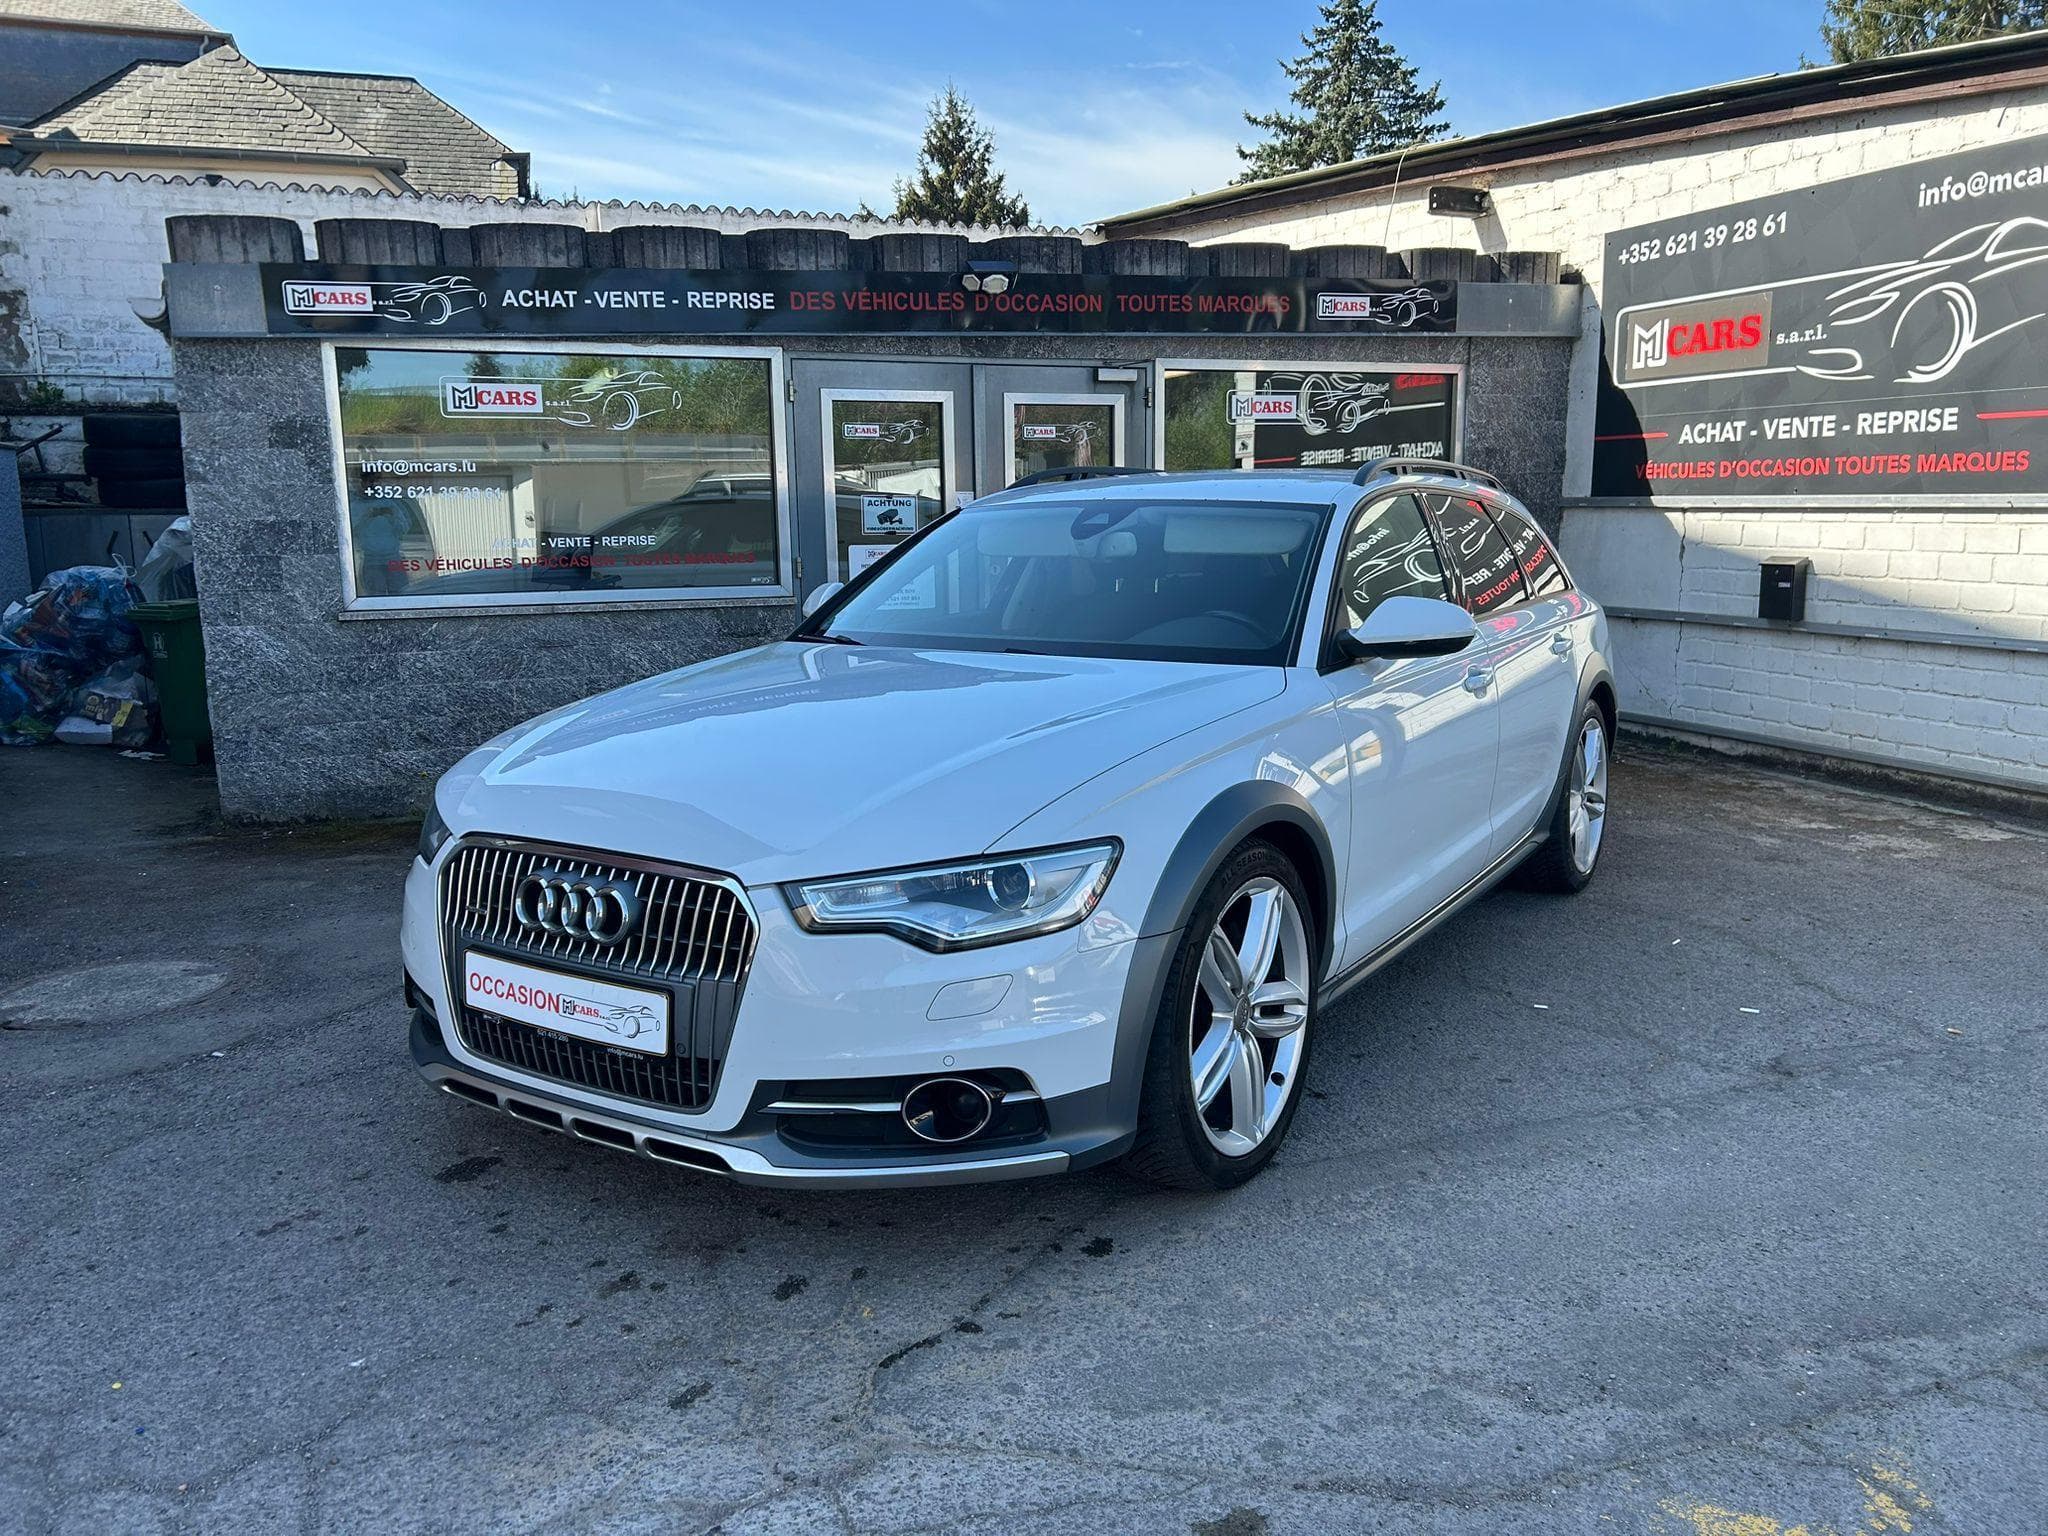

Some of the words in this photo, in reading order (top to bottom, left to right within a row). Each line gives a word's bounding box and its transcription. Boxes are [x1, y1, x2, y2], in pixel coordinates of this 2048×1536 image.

[1618, 238, 1661, 265] +352
[1665, 230, 1697, 257] 621
[1703, 224, 1728, 249] 39
[1732, 218, 1757, 243] 28
[1762, 211, 1787, 237] 61
[502, 289, 577, 308] ACHAT
[687, 291, 775, 310] REPRISE
[790, 291, 836, 311] DES
[841, 287, 965, 311] VÉHICULES
[975, 293, 1102, 313] D'OCCASION
[1117, 294, 1192, 313] TOUTES
[1199, 294, 1290, 314] MARQUES
[1667, 314, 1763, 359] CARS
[1775, 324, 1828, 345] s.a.r.l.
[477, 390, 537, 406] CARS
[1252, 401, 1293, 414] CARS
[1679, 421, 1746, 445] ACHAT
[1763, 415, 1837, 440] VENTE
[1856, 407, 1959, 435] REPRISE
[361, 460, 476, 475] info@mcars.lu
[1636, 460, 1715, 480] VÉHICULES
[1719, 457, 1831, 478] D'OCCASION
[1835, 454, 1911, 475] TOUTES
[1917, 450, 2030, 473] MARQUES
[364, 485, 402, 498] +352
[407, 485, 433, 499] 621
[439, 487, 458, 499] 39
[484, 487, 502, 499] 61
[867, 499, 912, 507] ACHTUNG
[492, 538, 537, 549] ACHAT
[548, 537, 591, 548] VENTE
[602, 535, 656, 547] REPRISE
[387, 559, 419, 572] DES
[425, 556, 513, 571] VÉHICULES
[522, 554, 616, 568] D'OCCASION
[623, 553, 679, 567] TOUTES
[685, 551, 756, 564] MARQUES
[470, 972, 560, 1014] OCCASION
